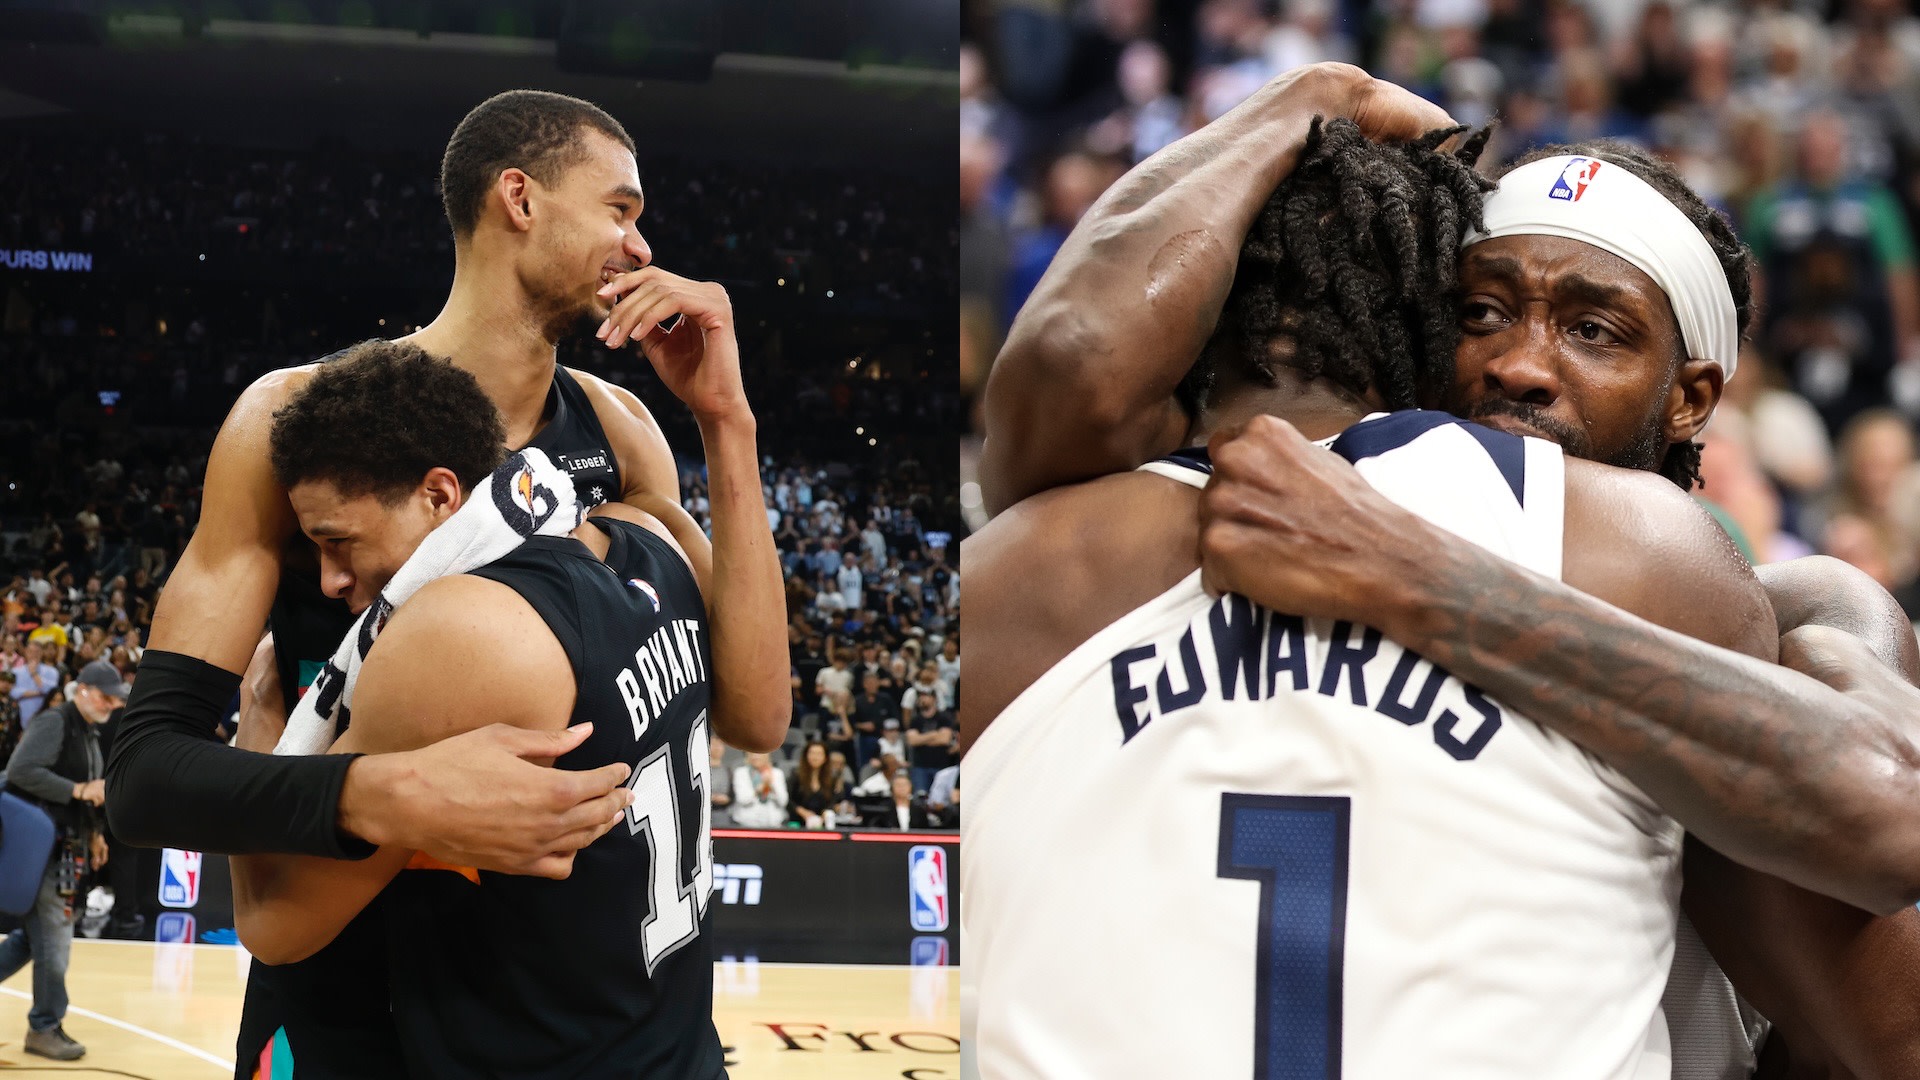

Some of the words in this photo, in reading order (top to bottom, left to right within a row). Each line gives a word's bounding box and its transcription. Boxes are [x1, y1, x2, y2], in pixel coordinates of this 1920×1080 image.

[1552, 188, 1570, 199] NBA
[50, 251, 93, 272] WIN
[568, 456, 607, 471] LEDGER
[615, 619, 706, 743] BRYANT
[625, 708, 714, 979] 11
[1217, 792, 1351, 1080] 1
